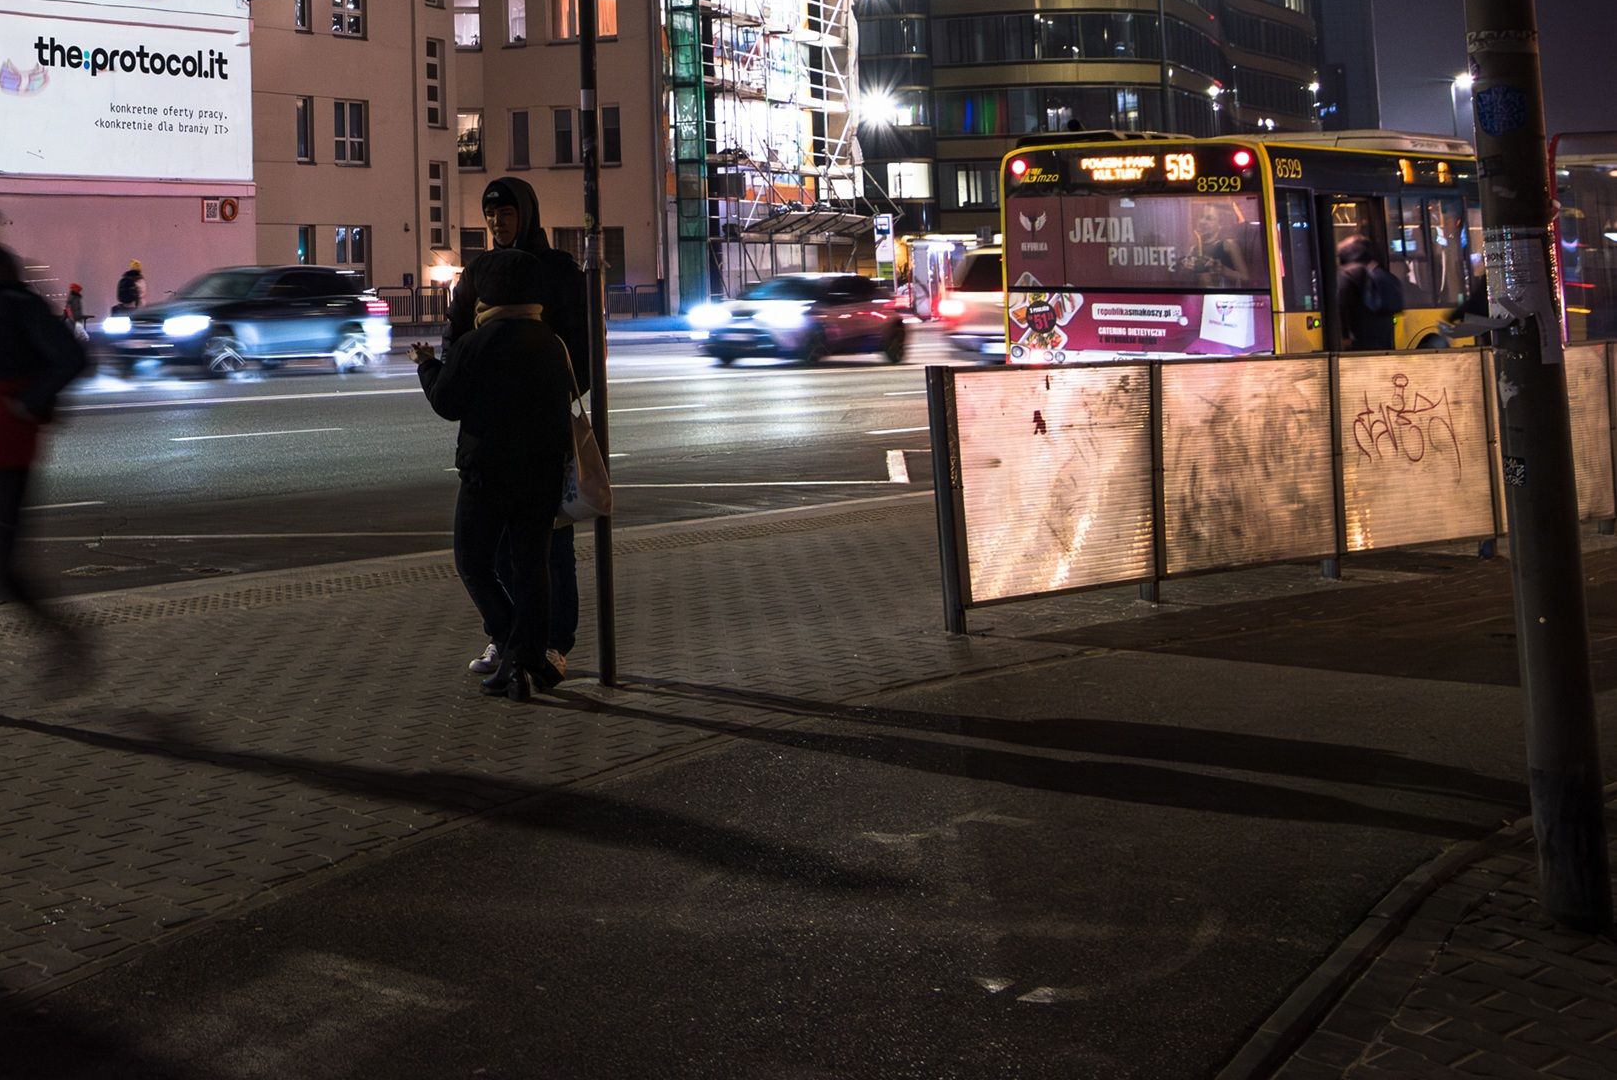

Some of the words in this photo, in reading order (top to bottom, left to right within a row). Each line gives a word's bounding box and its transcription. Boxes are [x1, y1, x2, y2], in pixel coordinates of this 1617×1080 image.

[110, 103, 158, 116] konkretne
[163, 106, 194, 120] oferty
[198, 109, 228, 121] pracy.
[94, 119, 153, 132] <konkretnie
[157, 121, 174, 132] dla
[178, 123, 209, 136] branży
[214, 125, 229, 135] IT>
[1093, 168, 1144, 181] KULTURY
[1165, 153, 1195, 180] 519
[1275, 157, 1303, 179] 8529
[1197, 176, 1241, 193] 8529
[1069, 216, 1135, 243] JAZDA
[1108, 247, 1131, 266] PO
[1133, 247, 1176, 272] DIETĘ
[1097, 308, 1171, 318] republikasmakoszy.pl
